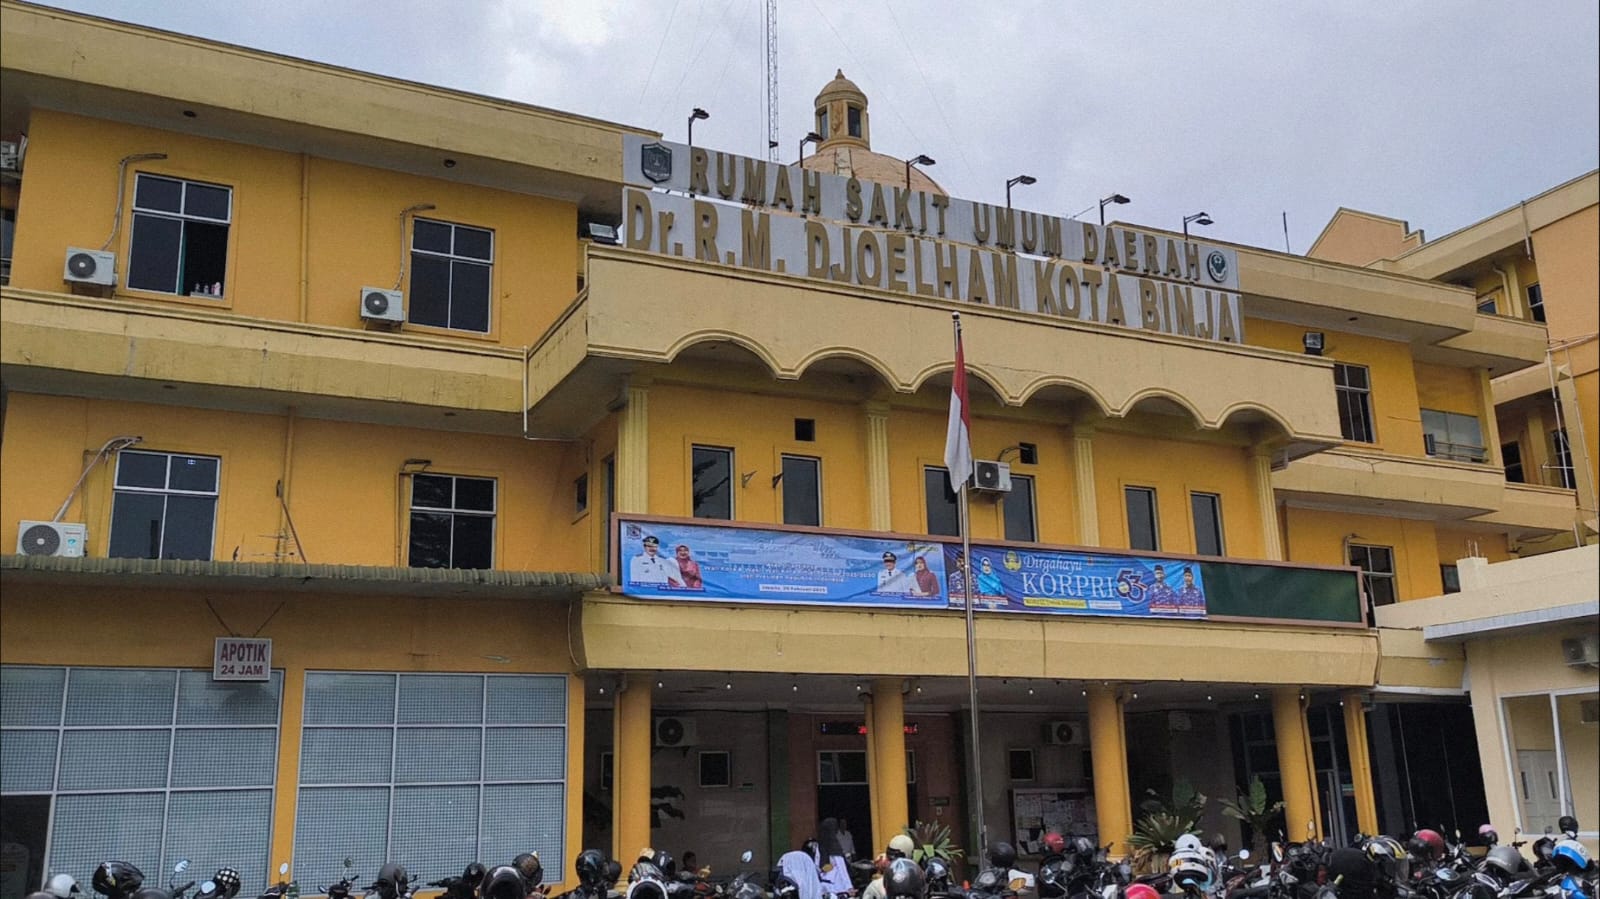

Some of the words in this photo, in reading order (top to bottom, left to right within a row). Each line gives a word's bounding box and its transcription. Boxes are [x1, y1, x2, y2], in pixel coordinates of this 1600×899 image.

[689, 146, 821, 215] RUMAH
[846, 176, 949, 237] SAKIT
[973, 202, 1062, 257] UMUM
[1082, 223, 1200, 281] DAERAH
[806, 219, 1020, 310] DJOELHAM
[1034, 261, 1126, 326] KOTA
[1023, 555, 1082, 575] Dirgahayu
[1021, 572, 1116, 598] KORPRI
[1115, 568, 1147, 603] 53
[221, 643, 266, 662] APOTIK
[221, 665, 235, 675] 24
[239, 665, 263, 675] JAM
